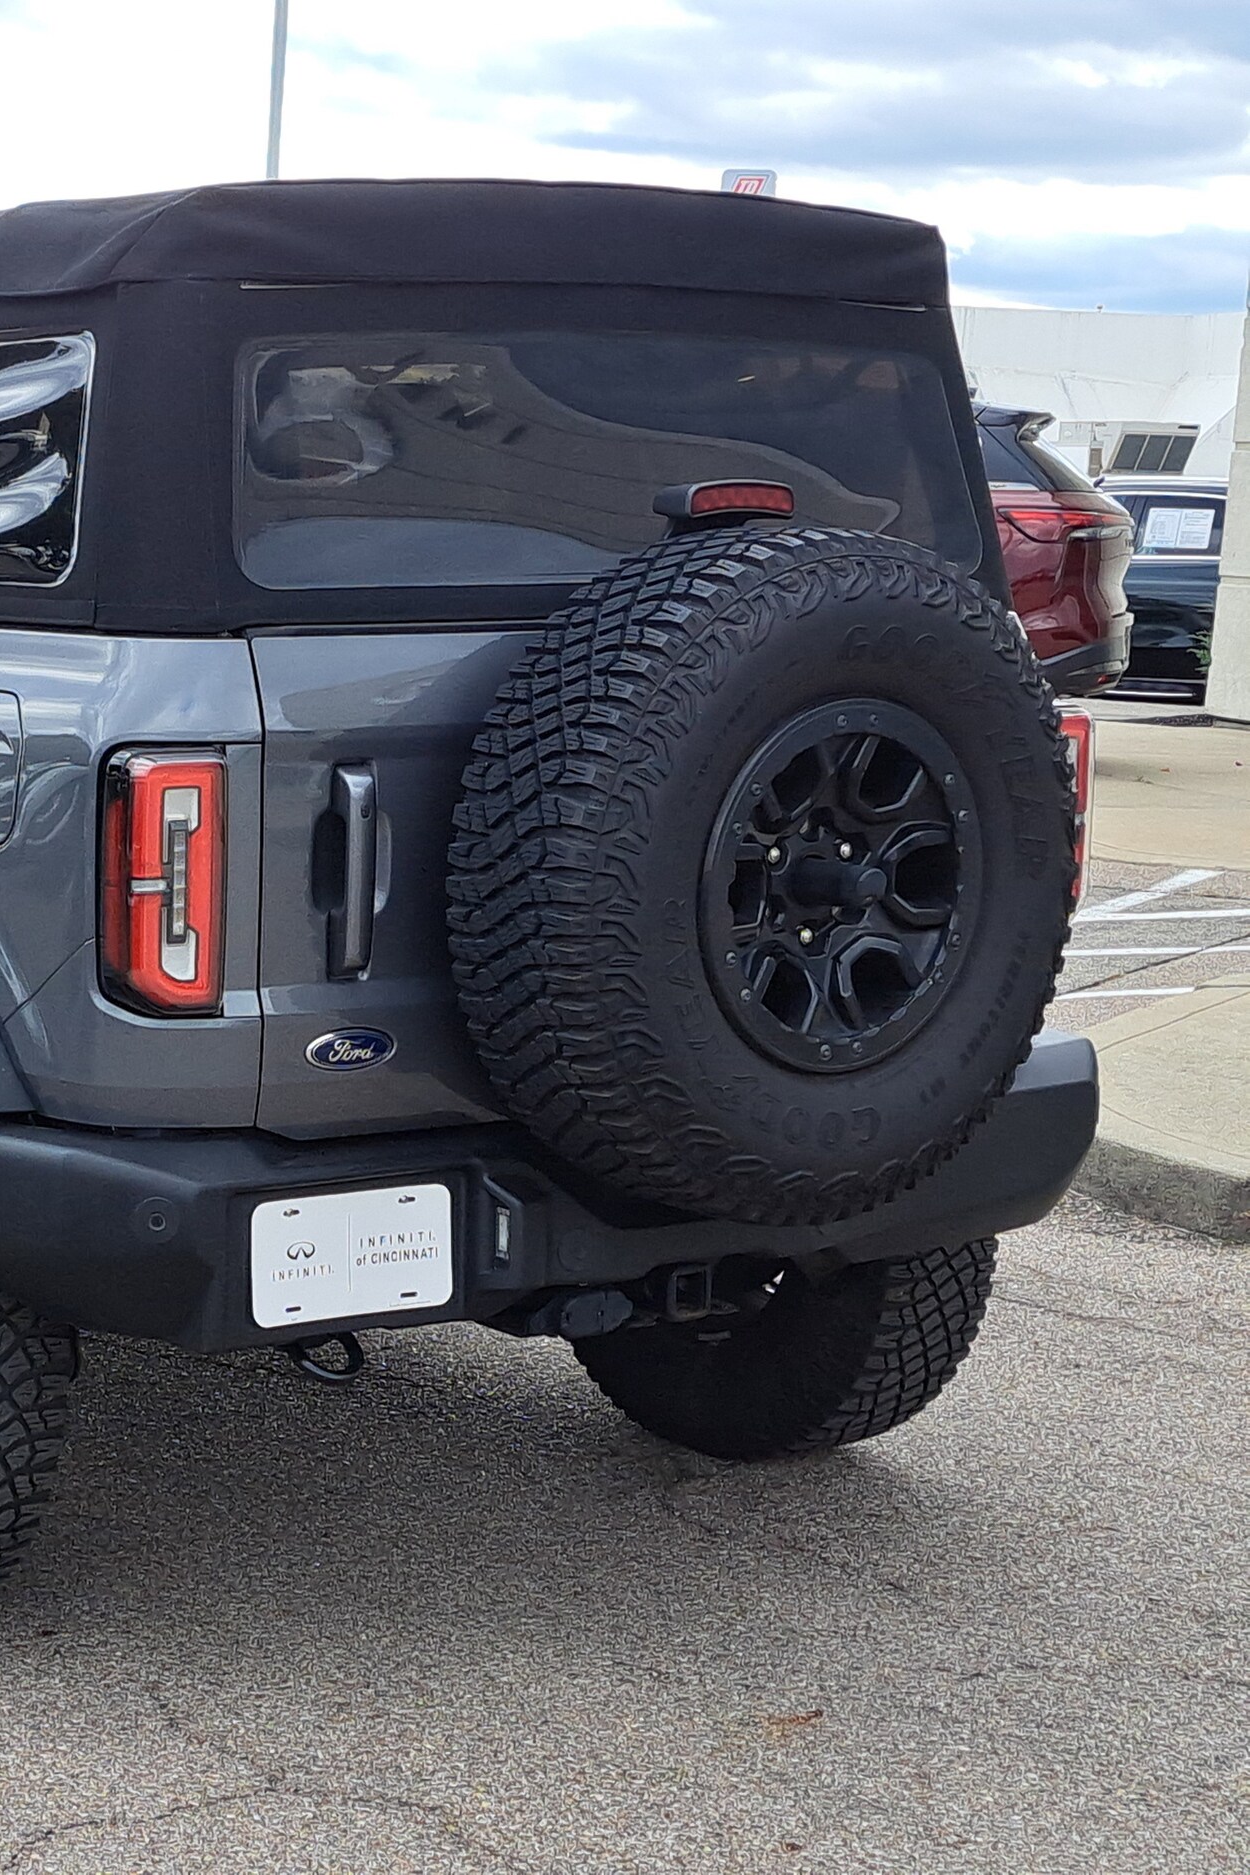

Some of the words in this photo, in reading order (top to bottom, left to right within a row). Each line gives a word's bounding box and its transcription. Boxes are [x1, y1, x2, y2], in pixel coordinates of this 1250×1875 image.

[328, 1038, 374, 1063] Ford
[359, 1230, 435, 1249] INFINITI
[356, 1254, 367, 1267] of
[370, 1246, 439, 1266] CINCINNATI
[271, 1264, 334, 1282] INFINITI
